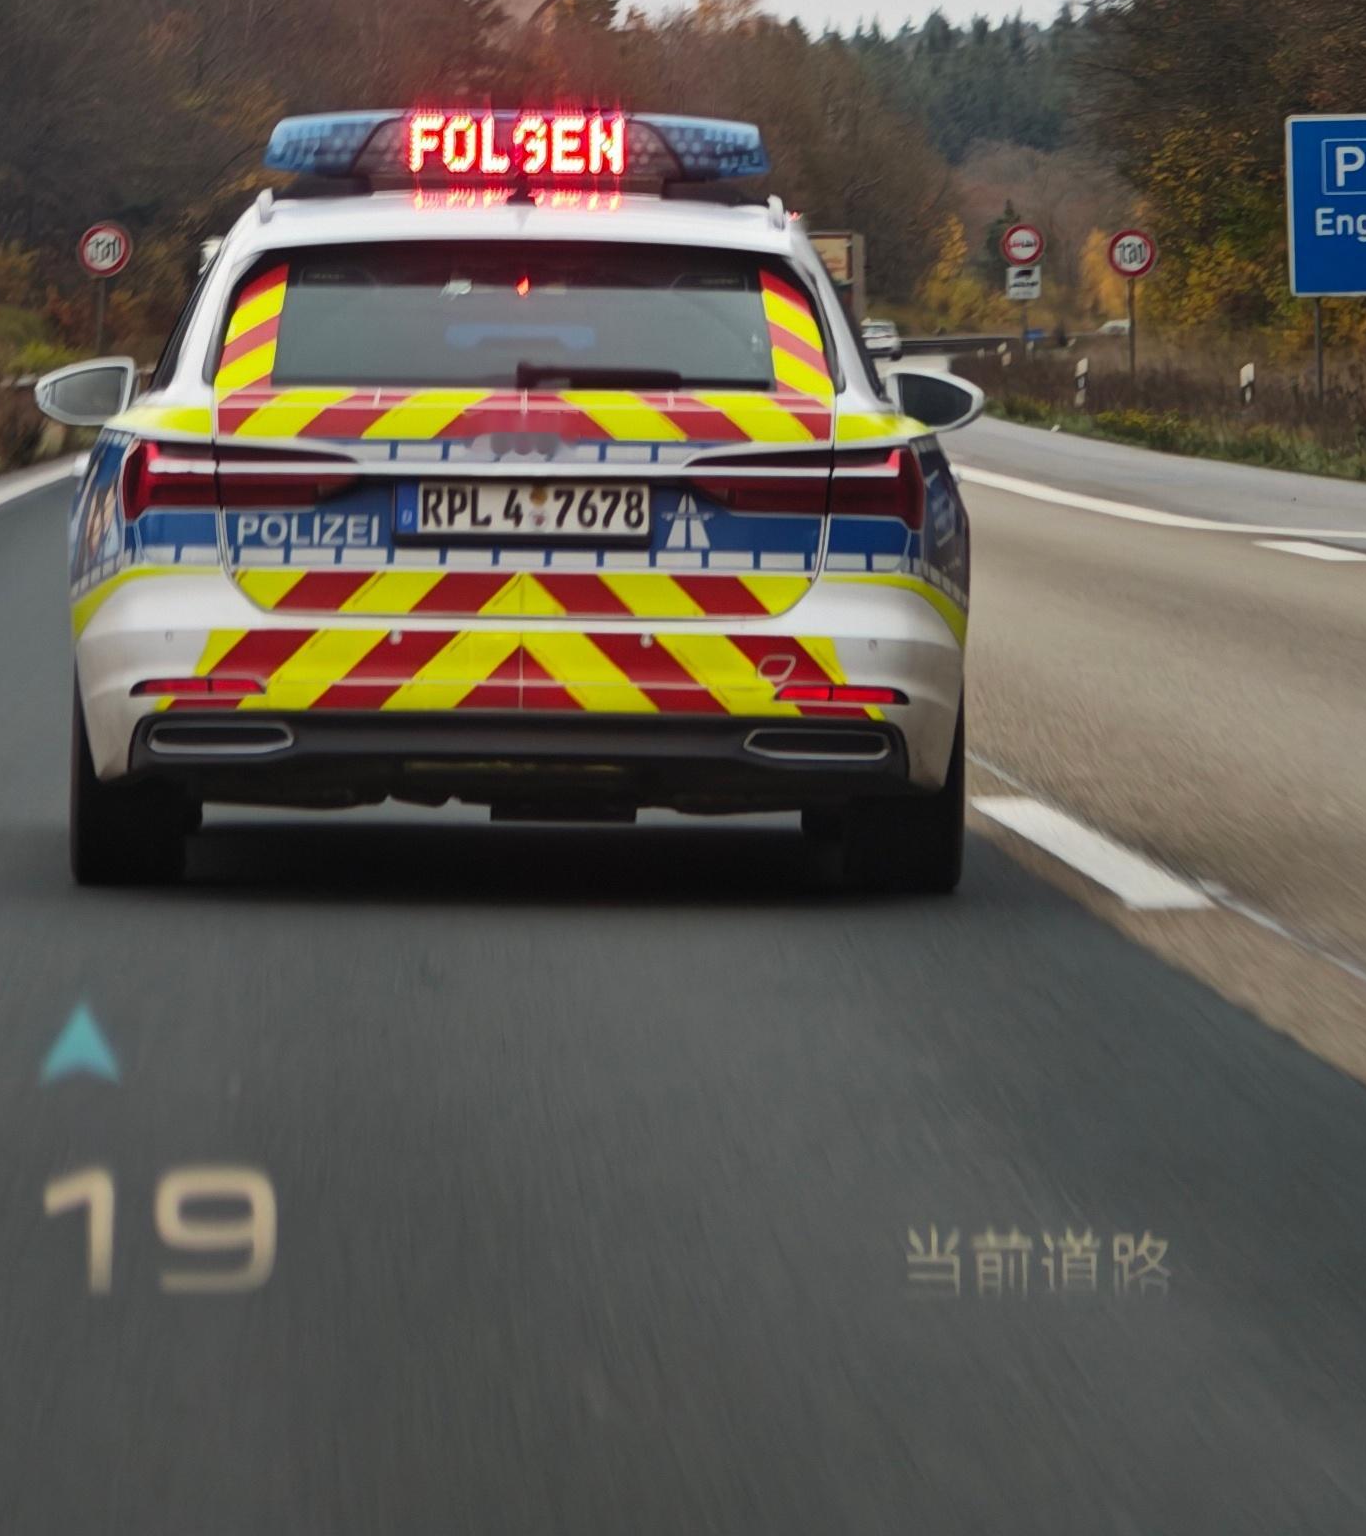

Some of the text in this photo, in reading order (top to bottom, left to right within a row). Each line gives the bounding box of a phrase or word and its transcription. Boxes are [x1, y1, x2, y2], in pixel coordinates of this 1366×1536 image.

[409, 114, 625, 174] FOLGEN
[1335, 146, 1366, 187] P
[421, 487, 645, 528] RPL 4 7678
[238, 513, 379, 546] POLIZEI
[905, 1223, 1172, 1298] 当前道路
